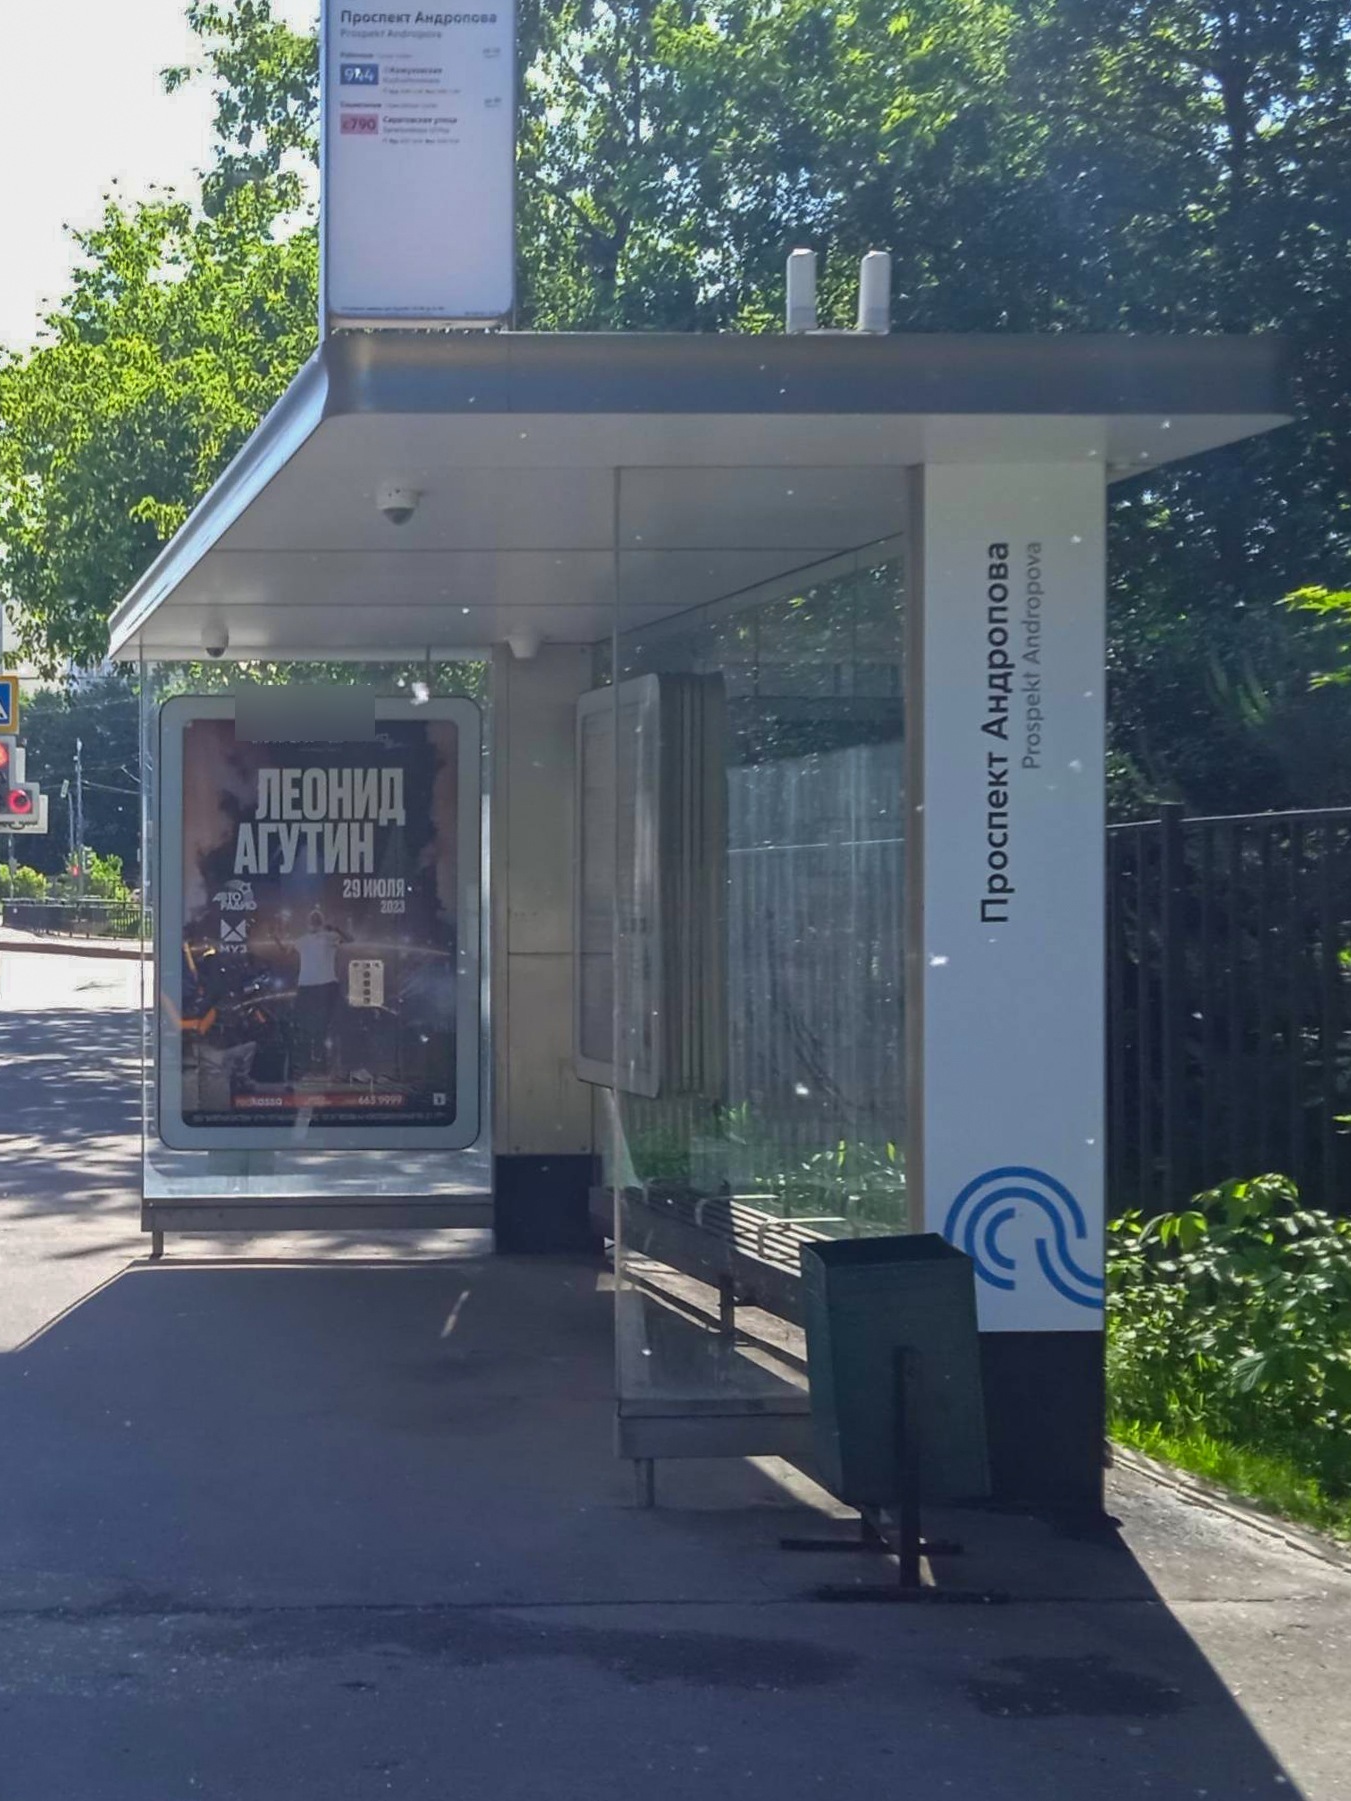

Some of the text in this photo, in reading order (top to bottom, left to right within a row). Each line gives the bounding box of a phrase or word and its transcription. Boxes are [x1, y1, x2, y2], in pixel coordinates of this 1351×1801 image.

[340, 10, 497, 26] Проспект Андропова
[1021, 541, 1045, 770] Prospekt Andropova
[980, 541, 1015, 923] Проспект Андропова
[255, 767, 406, 826] ЛЕОНИД
[234, 822, 374, 875] АГУТИН
[343, 879, 405, 898] 29 ИЮЛЯ
[380, 900, 405, 913] 2023
